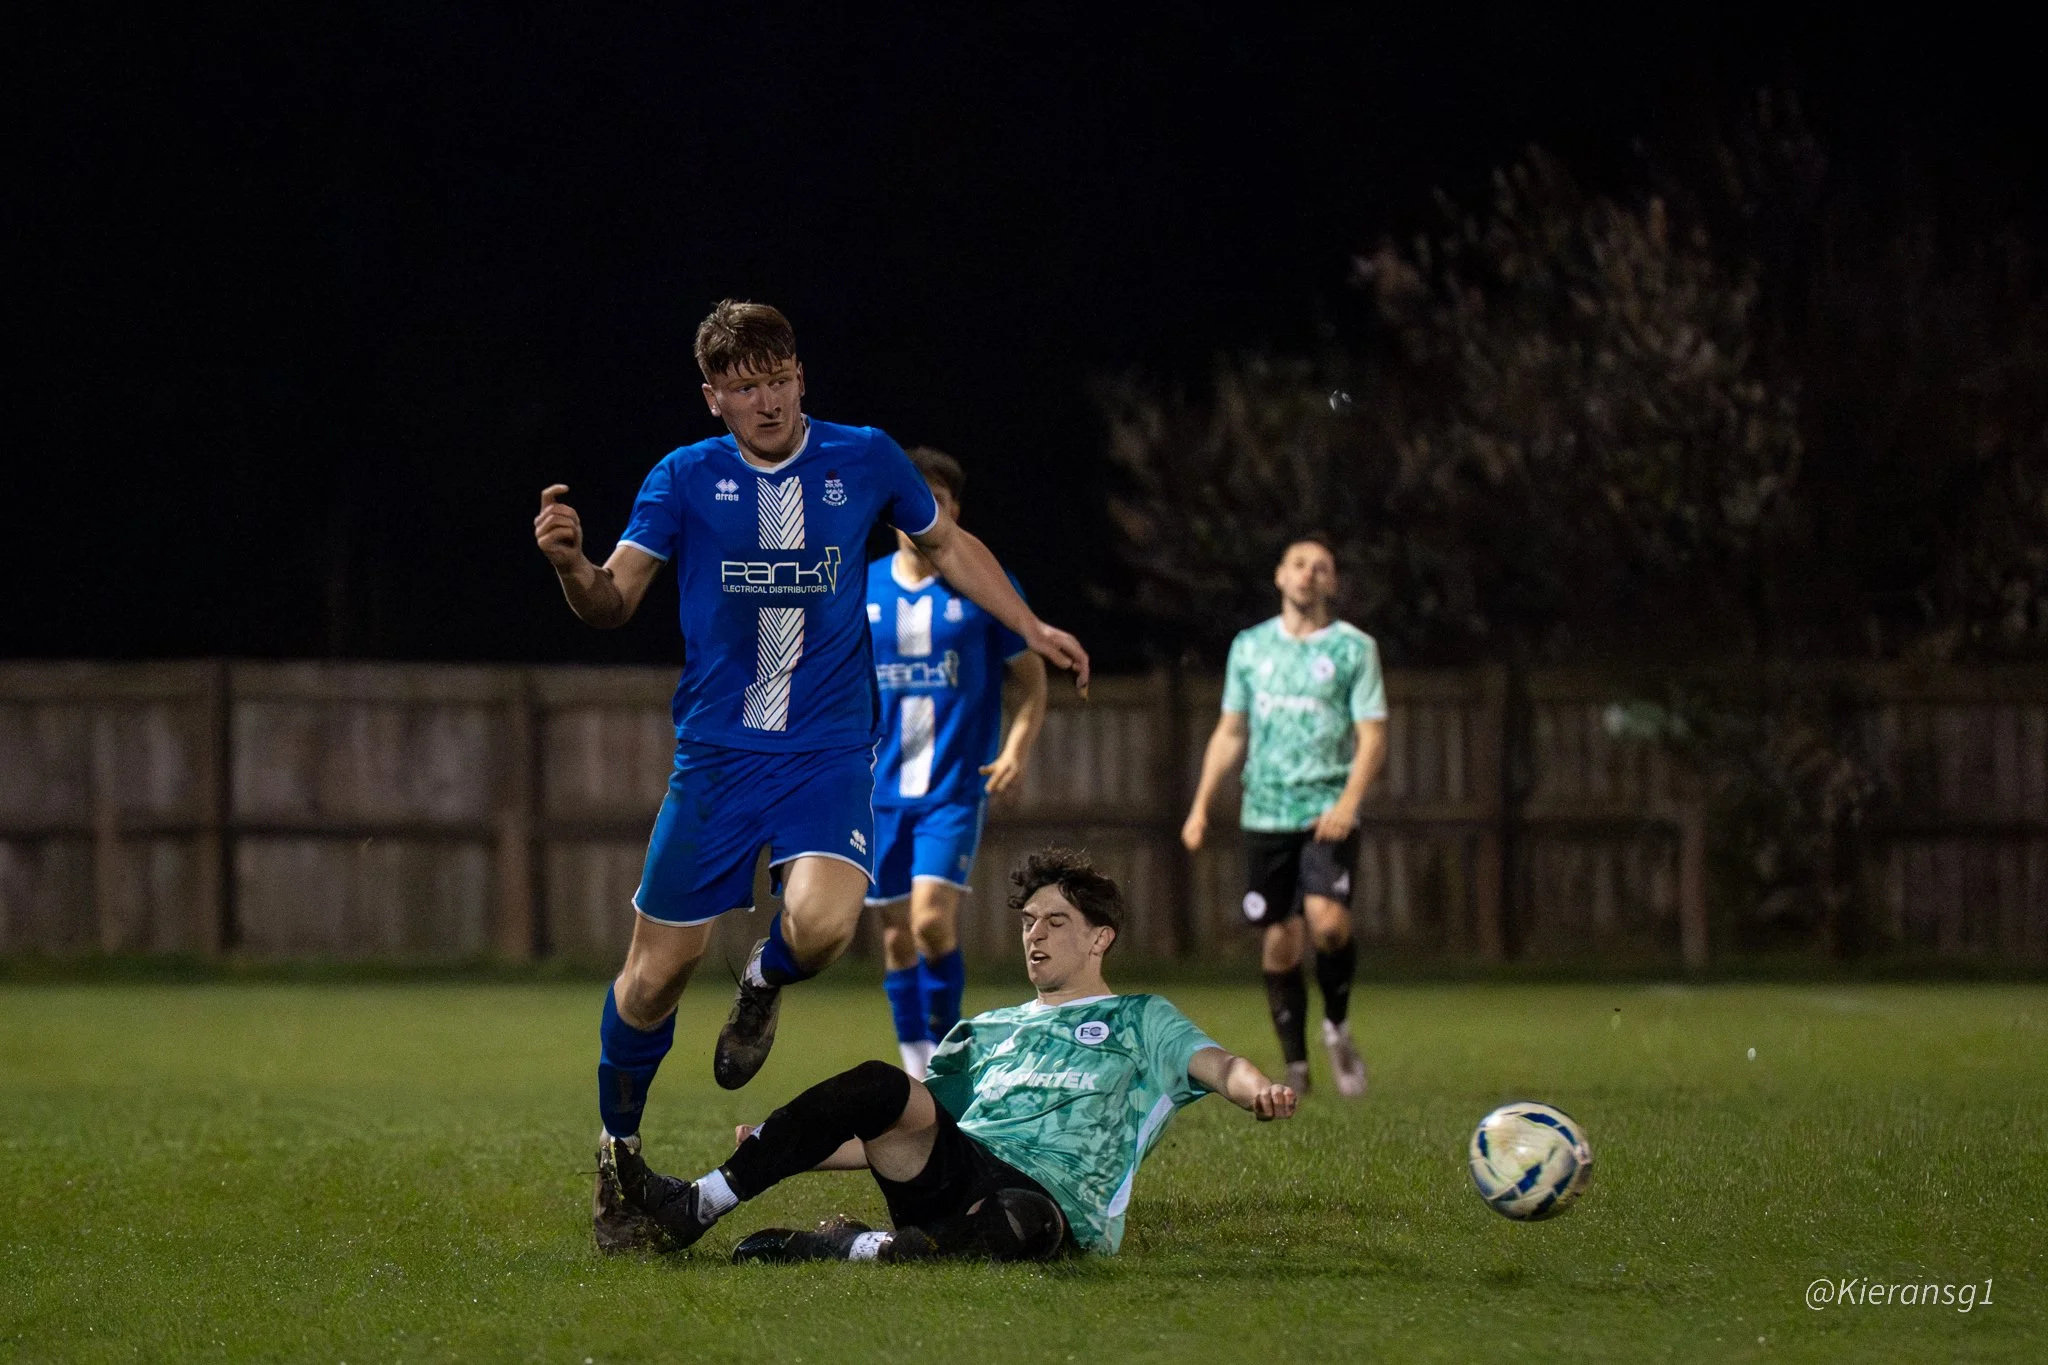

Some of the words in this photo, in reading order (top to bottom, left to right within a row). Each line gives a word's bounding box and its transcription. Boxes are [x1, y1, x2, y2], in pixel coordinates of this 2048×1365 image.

[722, 584, 768, 594] ELECTRICAL
[769, 585, 828, 594] DISTRIBUTORS
[1080, 1026, 1102, 1037] FC
